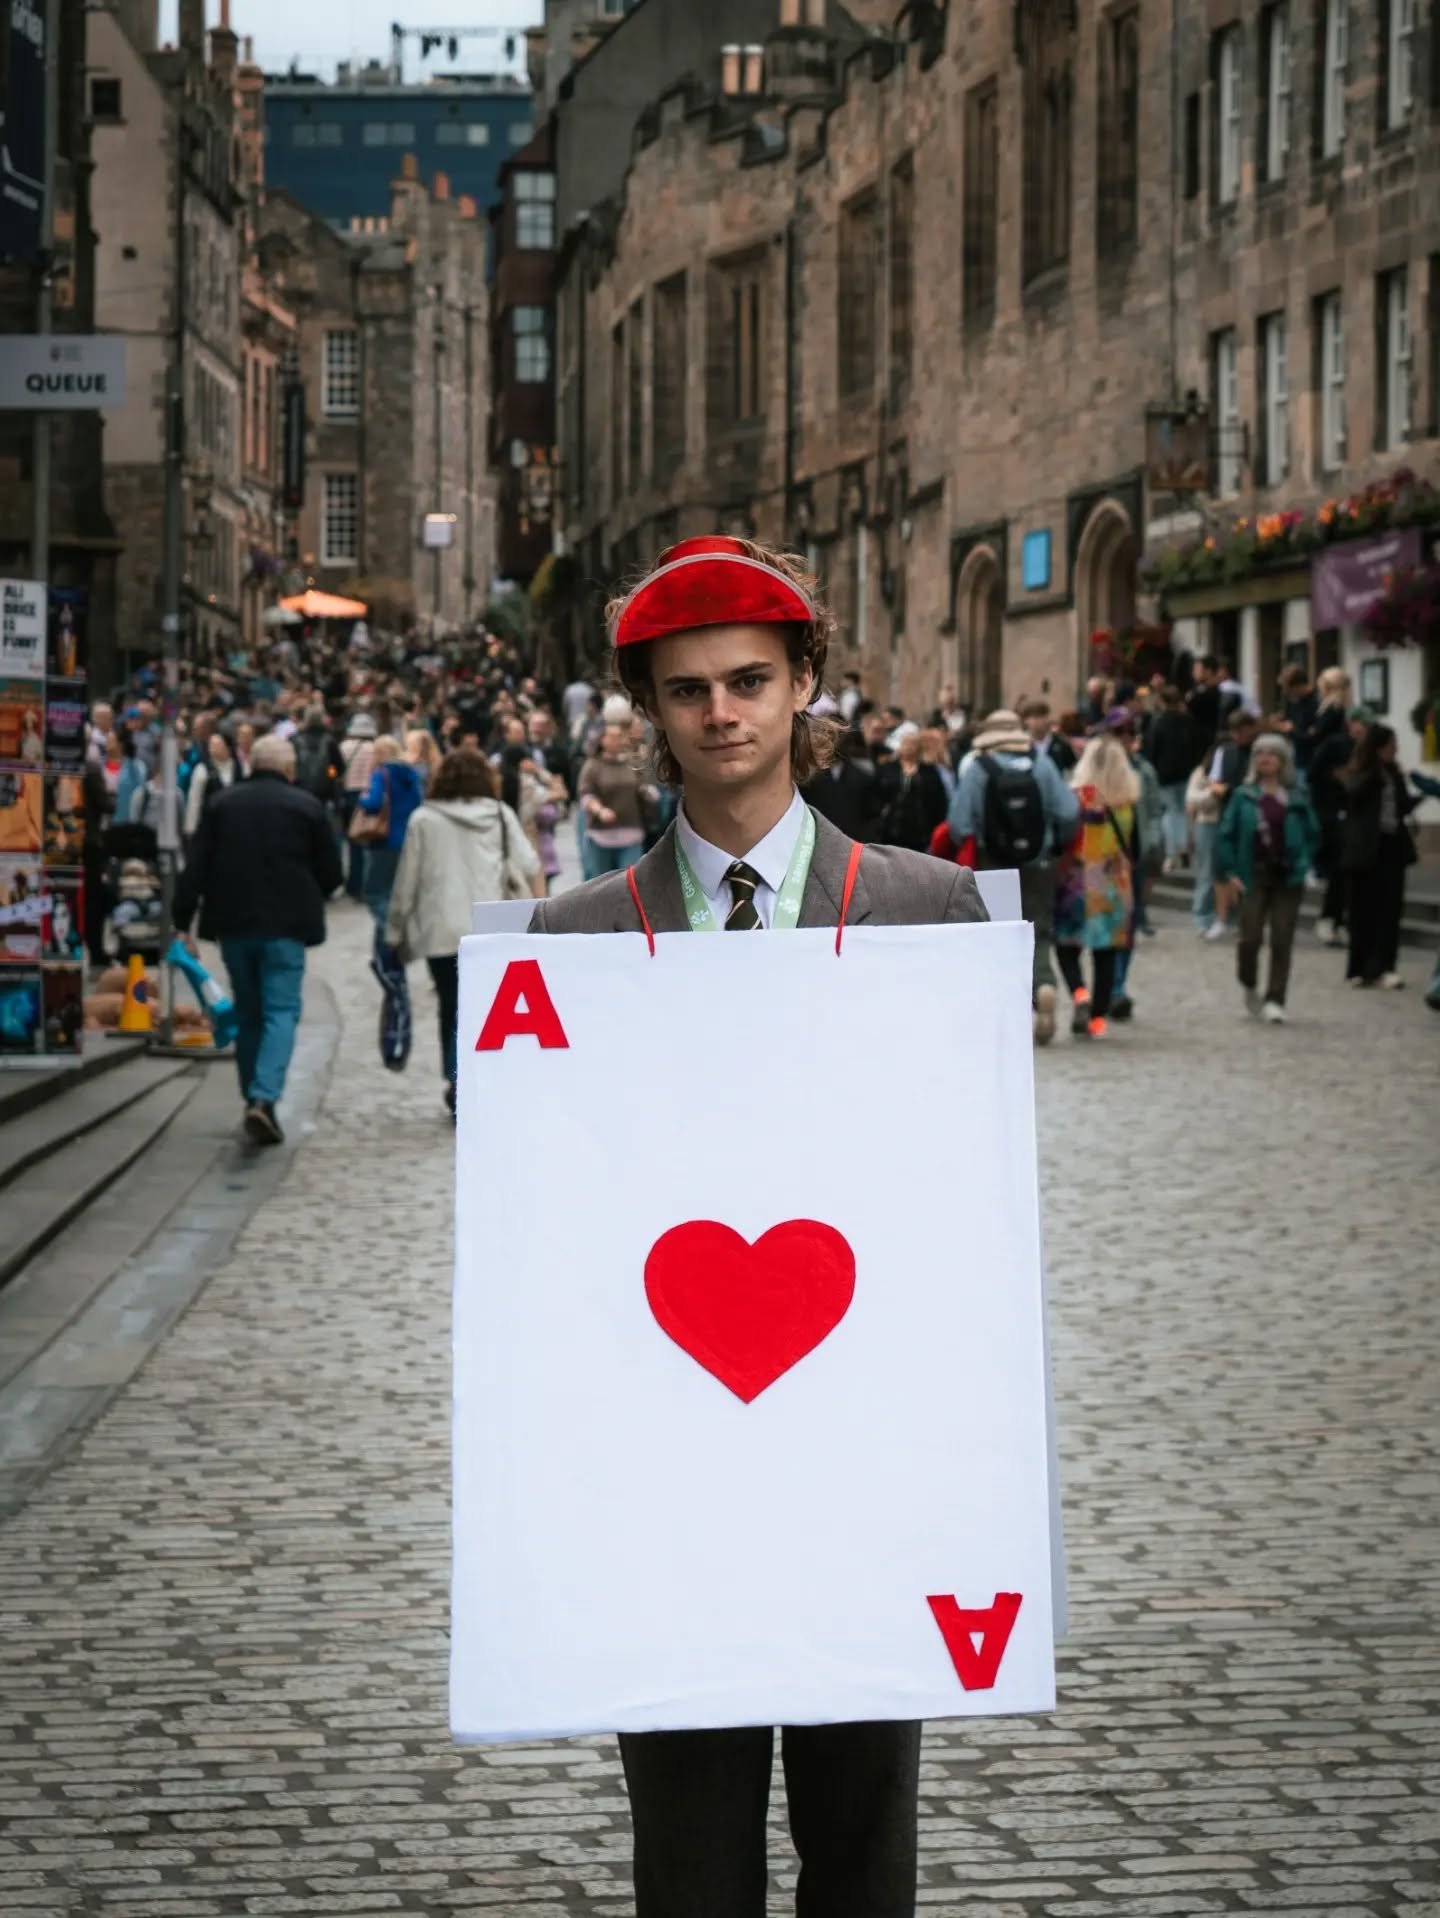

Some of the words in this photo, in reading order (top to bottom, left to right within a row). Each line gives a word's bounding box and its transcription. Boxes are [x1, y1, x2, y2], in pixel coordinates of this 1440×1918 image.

[25, 373, 107, 394] QUEUE
[475, 959, 570, 1051] A
[926, 1592, 1023, 1690] A
